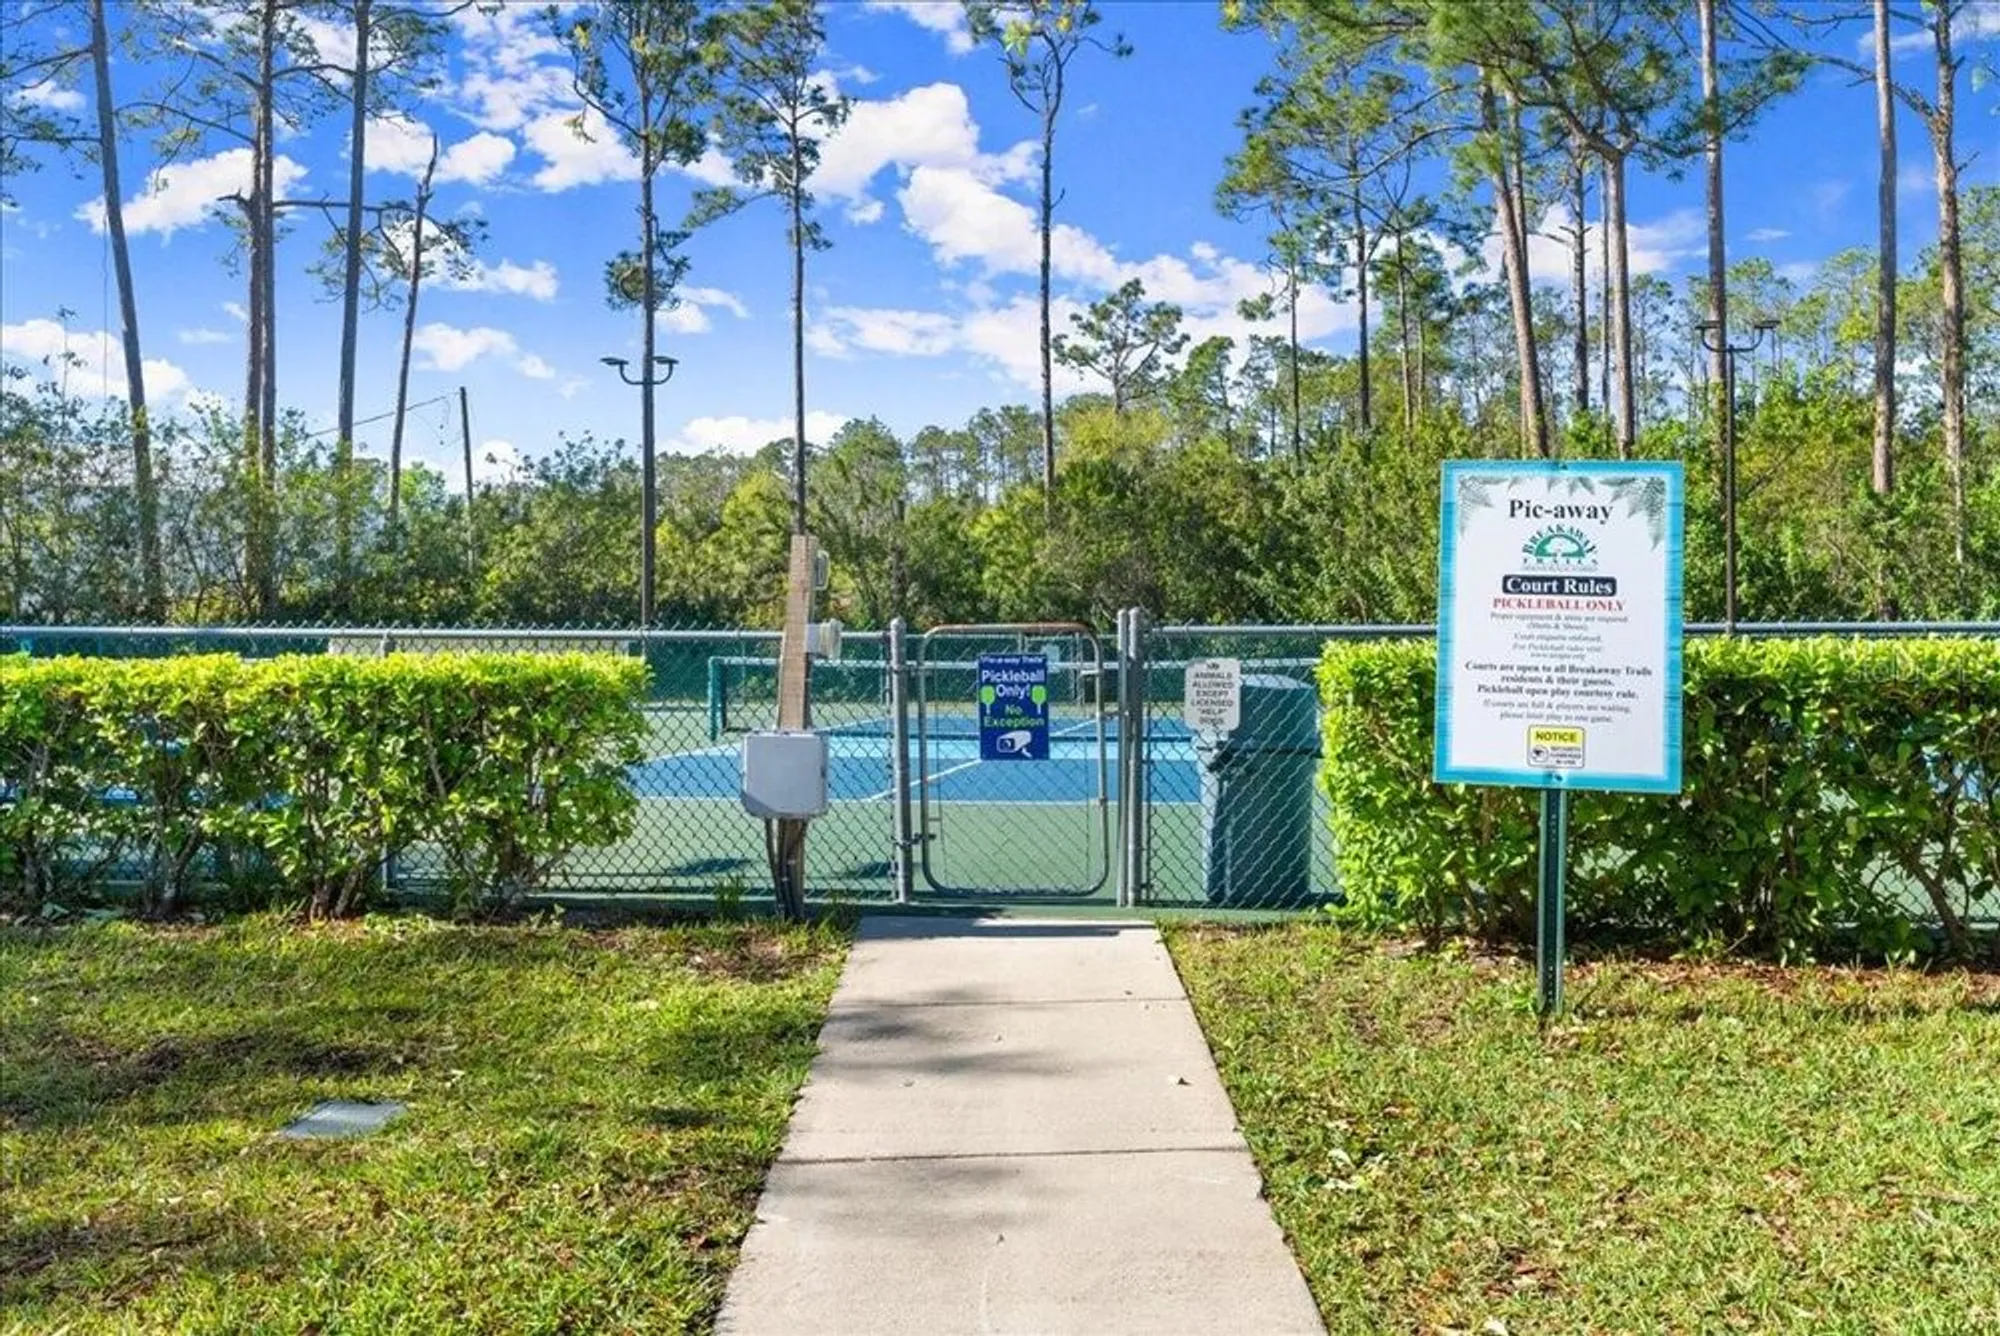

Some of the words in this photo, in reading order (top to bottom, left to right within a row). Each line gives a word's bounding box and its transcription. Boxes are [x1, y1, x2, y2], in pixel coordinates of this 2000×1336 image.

[1510, 499, 1613, 525] Pic-away
[1506, 576, 1559, 592] Court
[1563, 578, 1613, 594] Rules
[1493, 598, 1585, 610] PICKLEBALL
[1586, 600, 1625, 611] ONLY
[1464, 660, 1497, 670] Courts
[1500, 663, 1514, 671] are
[1516, 664, 1539, 673] open
[1541, 664, 1552, 672] to
[1554, 664, 1567, 672] all
[1568, 664, 1621, 676] Breakaway
[1626, 665, 1653, 676] Trails
[981, 669, 1046, 682] Pickleball
[1500, 674, 1543, 683] residents
[1545, 674, 1554, 683] &
[1556, 676, 1579, 685] their
[996, 683, 1031, 700] Only!
[1191, 681, 1235, 689] ALLOWED
[1477, 684, 1523, 693] Pickleball
[1525, 687, 1548, 697] open
[1550, 688, 1570, 698] play
[1574, 688, 1613, 700] courtesy
[1004, 703, 1024, 716] No
[983, 715, 1046, 729] Exception
[1535, 731, 1577, 742] NOTICE
